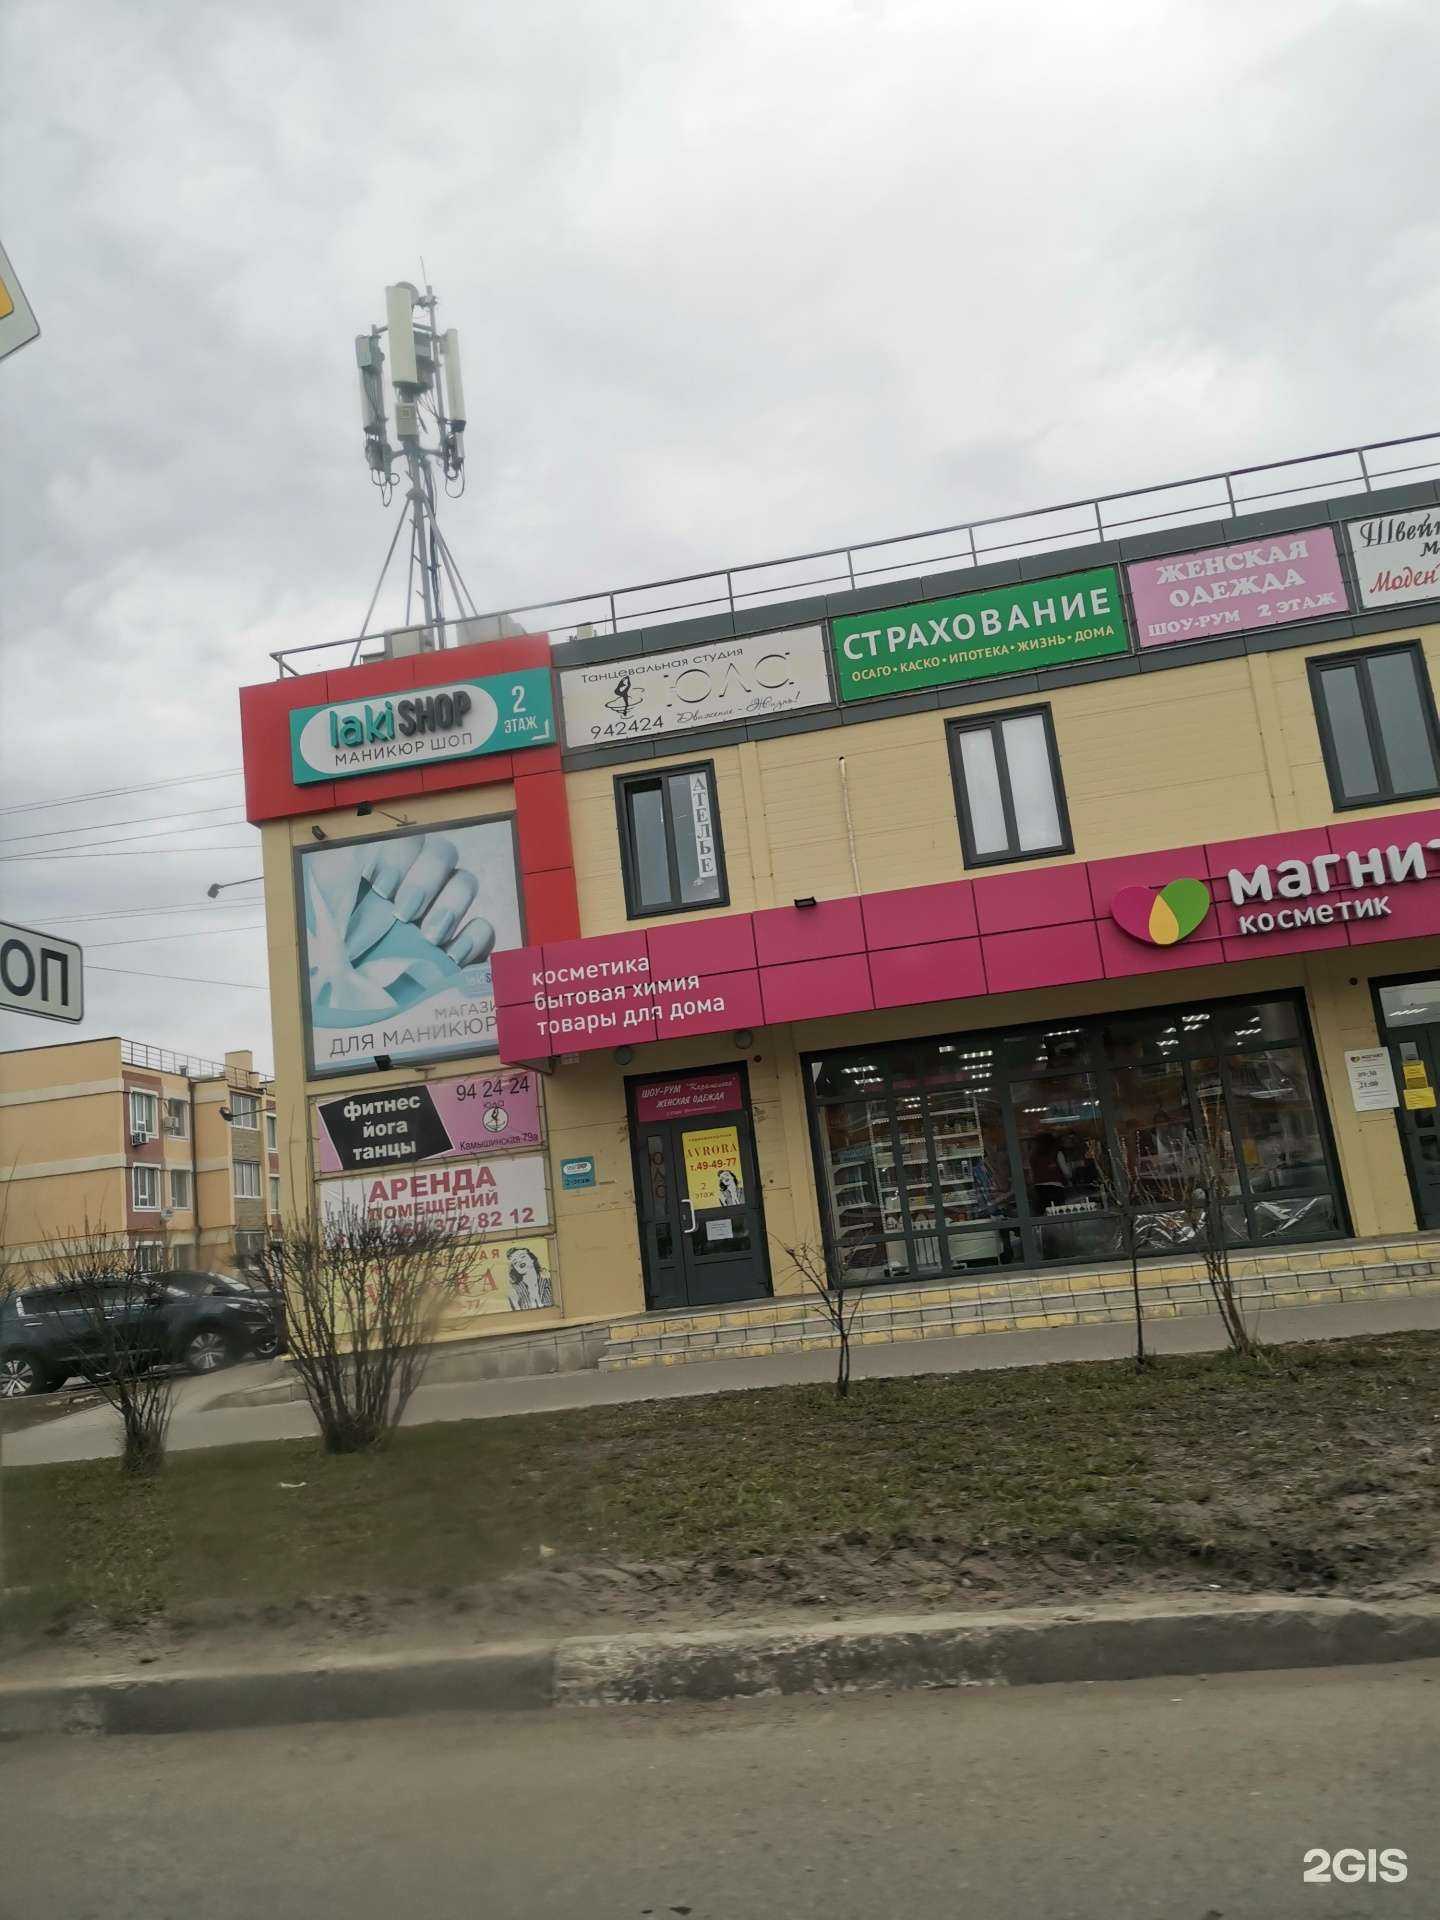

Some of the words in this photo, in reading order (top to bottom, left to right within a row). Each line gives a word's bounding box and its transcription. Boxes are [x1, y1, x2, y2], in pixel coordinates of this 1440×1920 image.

[1156, 540, 1309, 585] ЖЕНСКАЯ
[1169, 568, 1306, 608] ОДЕЖДА
[843, 588, 1110, 660] СТРАХОВАНИЕ
[1147, 609, 1241, 637] ШОУ-РУМ
[1257, 602, 1272, 617] 2
[1277, 592, 1337, 615] ЭТАЖ
[852, 665, 892, 682] ОСАГО
[900, 656, 940, 673] КАСКО
[949, 644, 1010, 664] ИПОТЕКА
[1017, 634, 1066, 652] ЖИЗНЬ
[1074, 624, 1115, 644] ДОМА
[511, 685, 527, 713] 2
[504, 714, 539, 735] ЭТАЖ
[590, 715, 664, 740] 942424
[335, 741, 424, 766] МАНИКЮР
[430, 732, 473, 752] ШОП
[1239, 895, 1392, 935] косметик
[533, 957, 650, 987] косметика
[534, 984, 625, 1011] бытовая
[632, 974, 700, 999] химия
[536, 1009, 617, 1037] товары
[623, 1003, 664, 1028] для
[670, 994, 726, 1021] дома
[329, 1033, 375, 1057] ДЛЯ
[456, 1083, 477, 1101] 94
[482, 1080, 503, 1098] 24
[510, 1075, 530, 1095] 24
[343, 1095, 421, 1122] фитнес
[362, 1118, 408, 1139] йога
[352, 1140, 417, 1161] танцы
[368, 1166, 497, 1202] АРЕНДА
[367, 1190, 499, 1222] ПОМЕЩЕНИЙ
[477, 1211, 502, 1229] 82
[510, 1207, 535, 1225] 12
